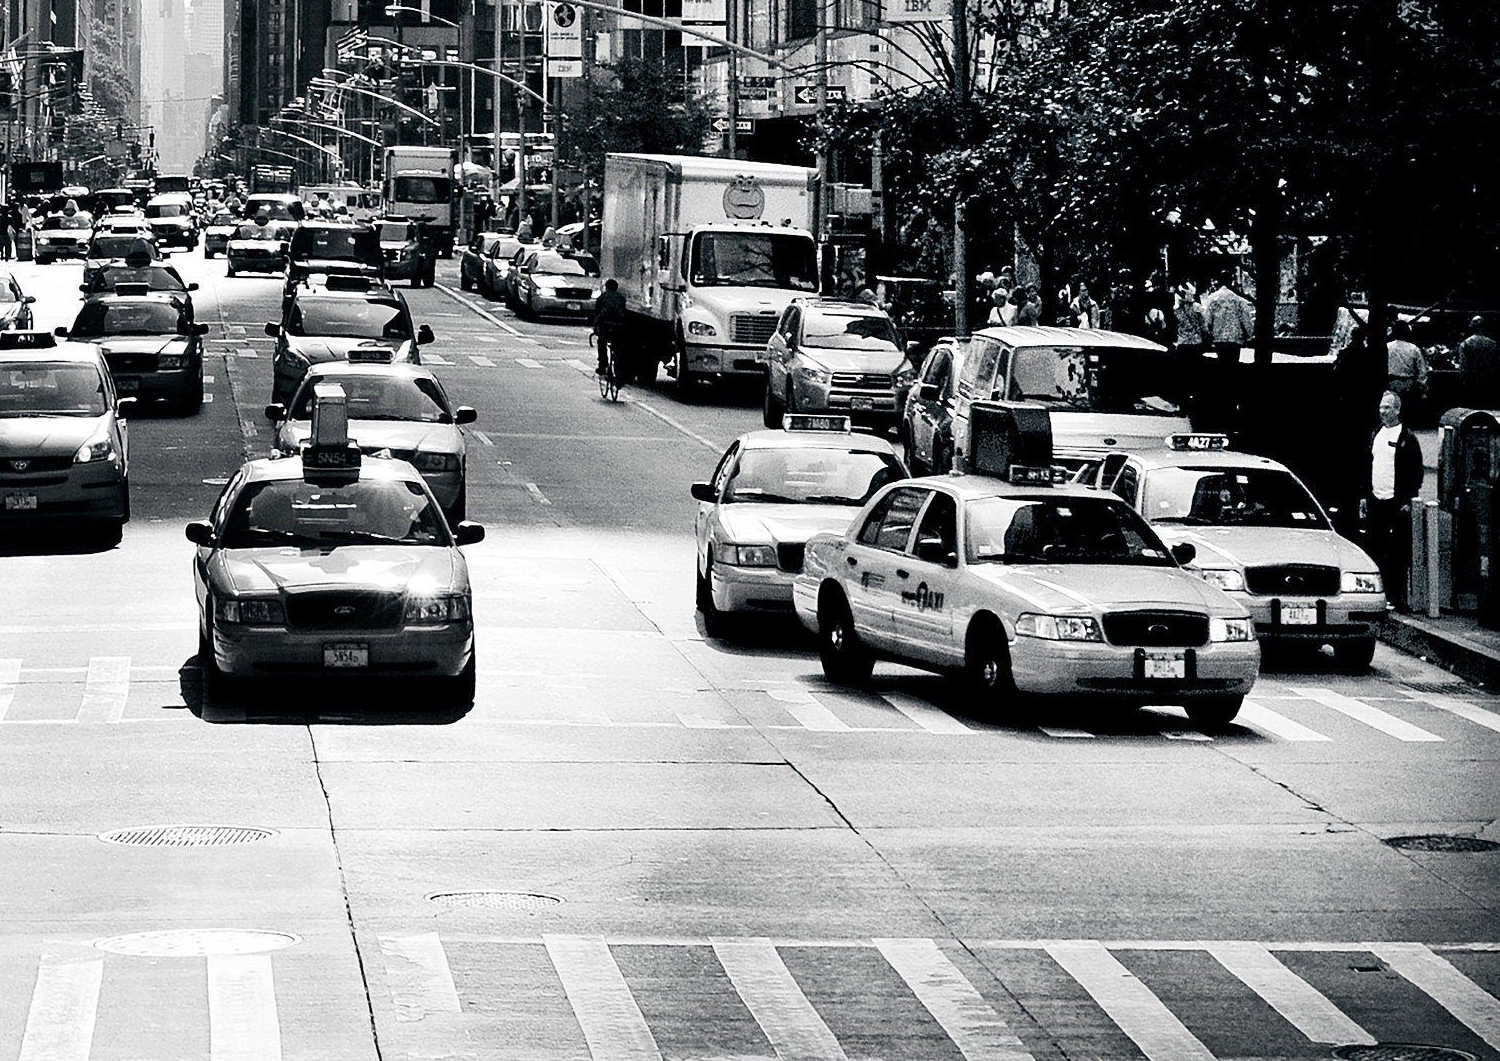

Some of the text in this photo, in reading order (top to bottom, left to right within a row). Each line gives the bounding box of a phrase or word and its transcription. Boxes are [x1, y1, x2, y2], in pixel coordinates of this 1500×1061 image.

[905, 0, 931, 12] IBM
[1188, 437, 1210, 448] 4A27
[318, 452, 346, 464] 5N54
